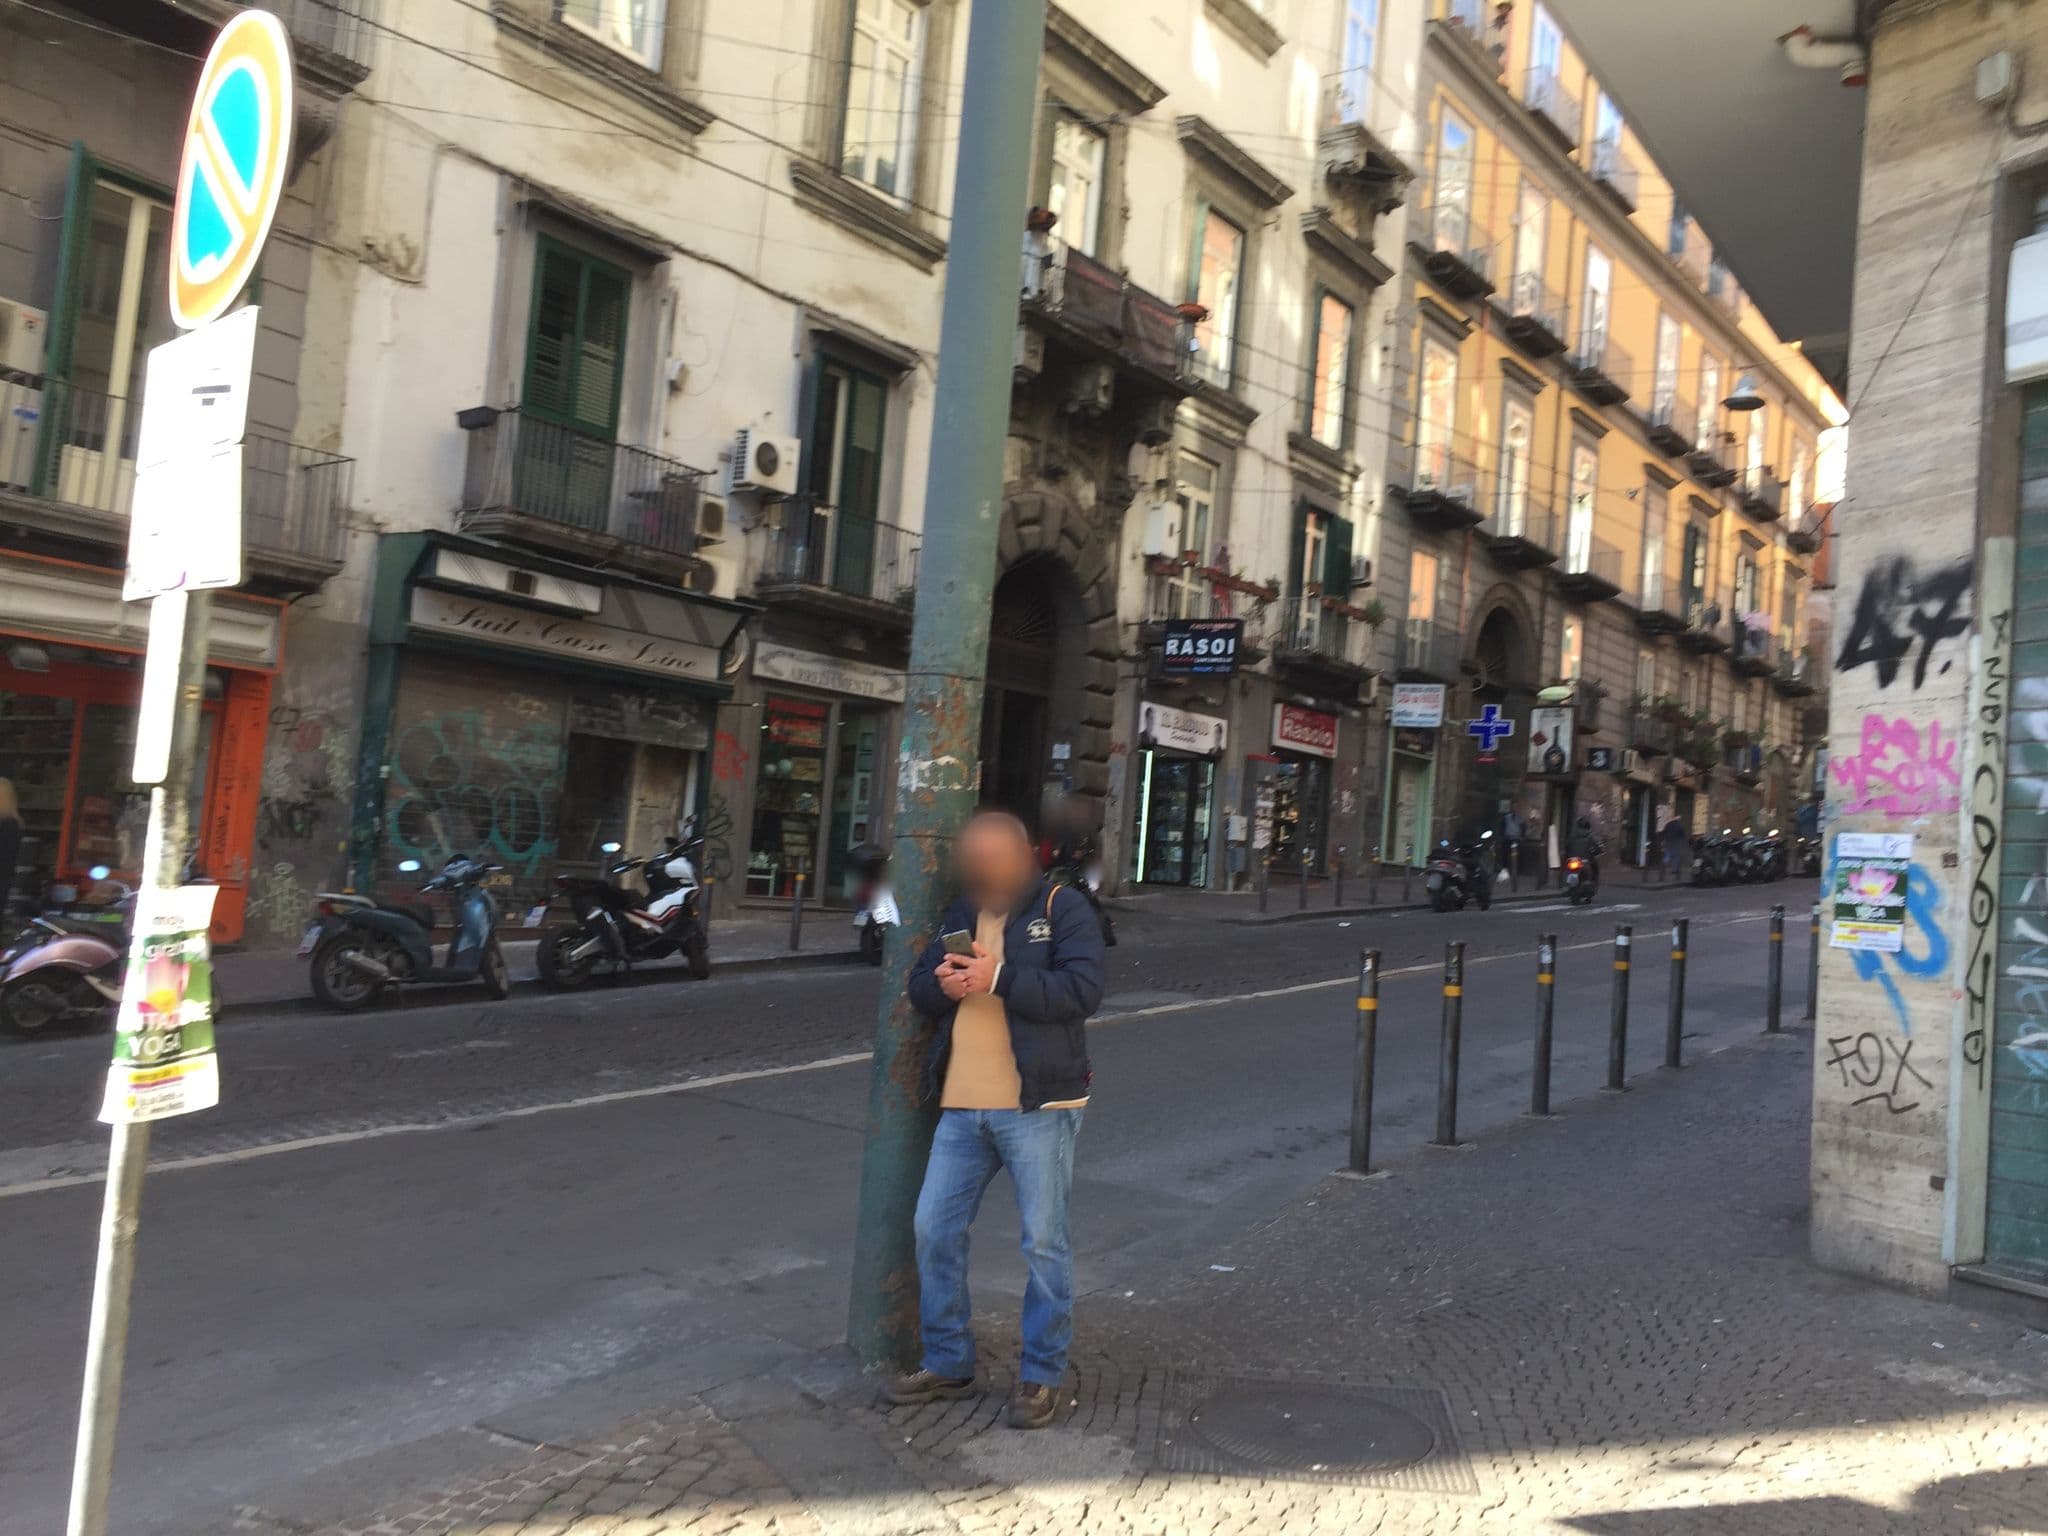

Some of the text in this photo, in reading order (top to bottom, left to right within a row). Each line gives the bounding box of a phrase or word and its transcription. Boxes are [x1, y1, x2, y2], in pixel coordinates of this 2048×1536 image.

[442, 606, 698, 671] Suit Case Line
[1165, 637, 1236, 656] RASOI
[127, 1032, 182, 1058] YOGA
[1827, 1031, 1934, 1097] FOX
